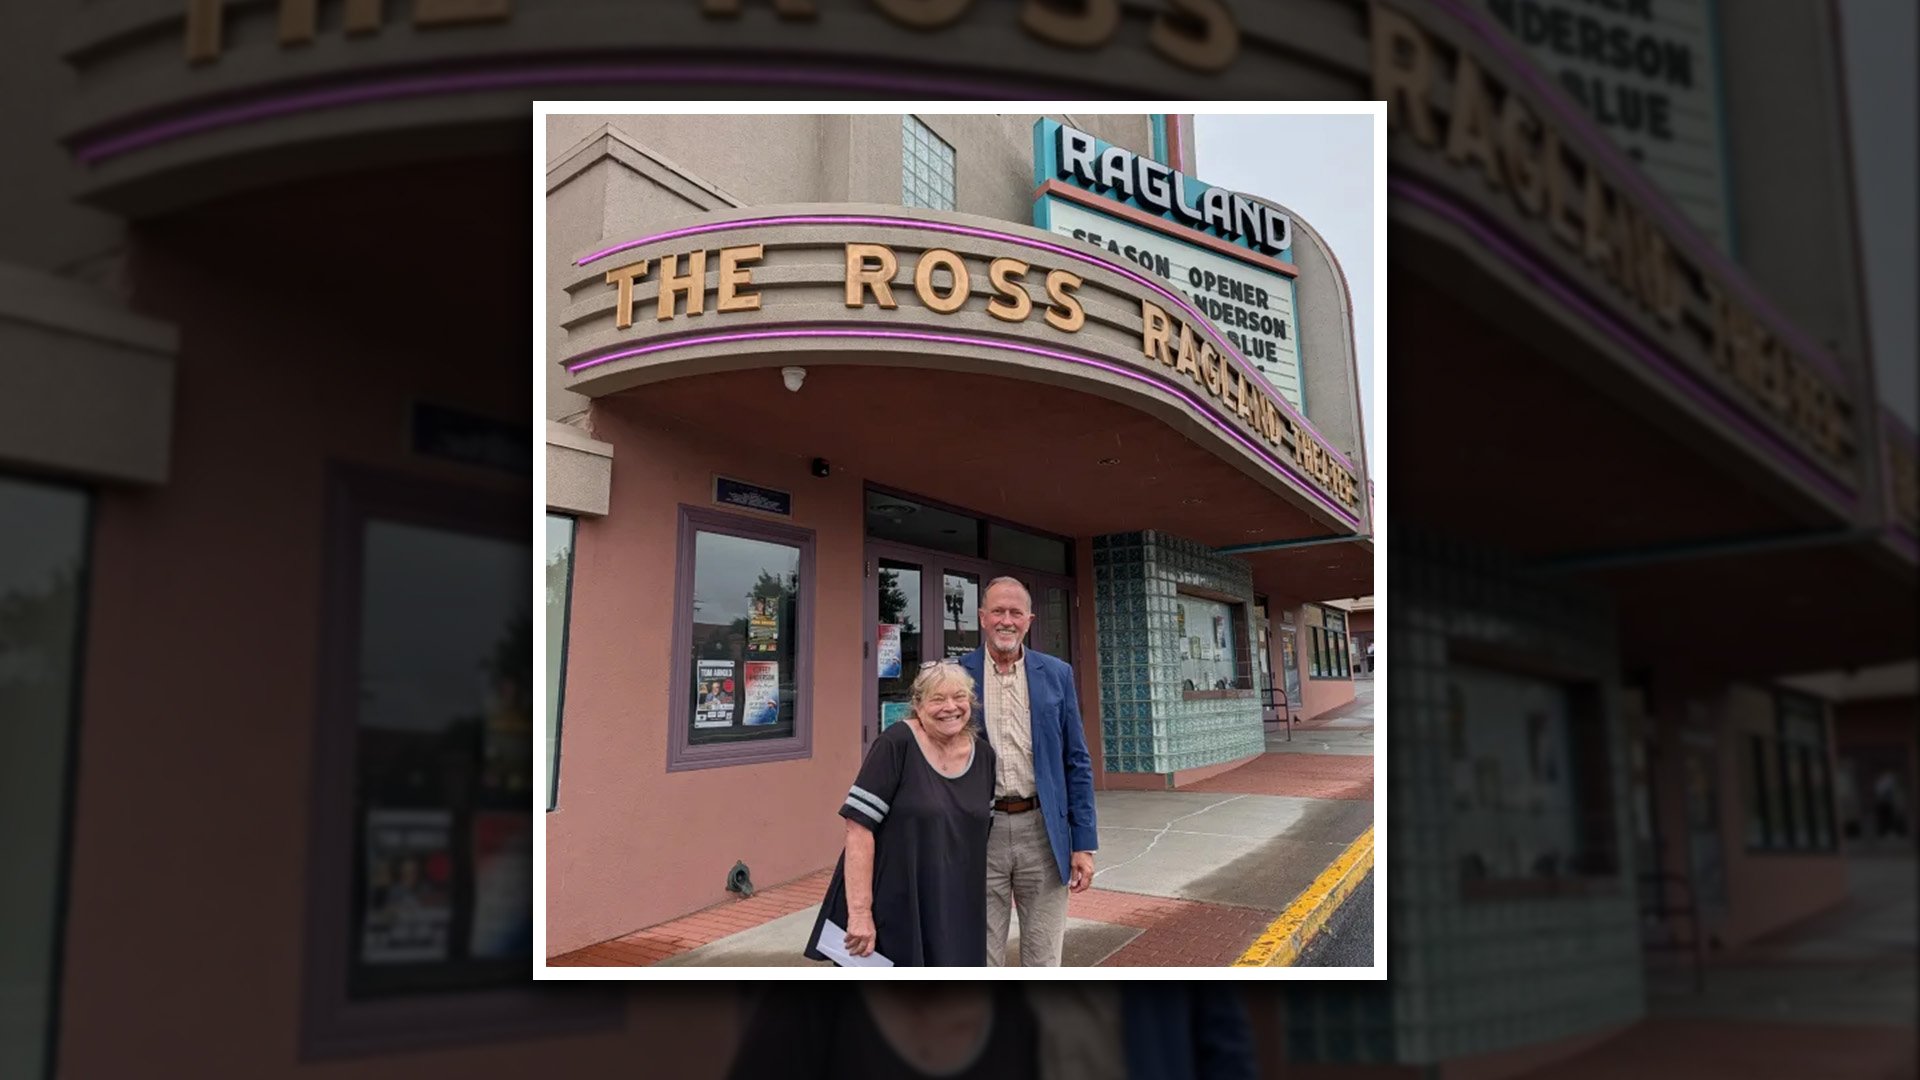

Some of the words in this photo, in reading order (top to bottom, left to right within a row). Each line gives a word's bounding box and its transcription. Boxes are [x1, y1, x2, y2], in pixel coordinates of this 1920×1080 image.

[1057, 125, 1292, 252] RAGLAND
[1181, 289, 1286, 341] NDERSON
[1189, 266, 1269, 310] OPENER
[605, 243, 764, 330] THE
[845, 242, 1085, 333] ROSS
[1142, 299, 1283, 447] RAGLAND
